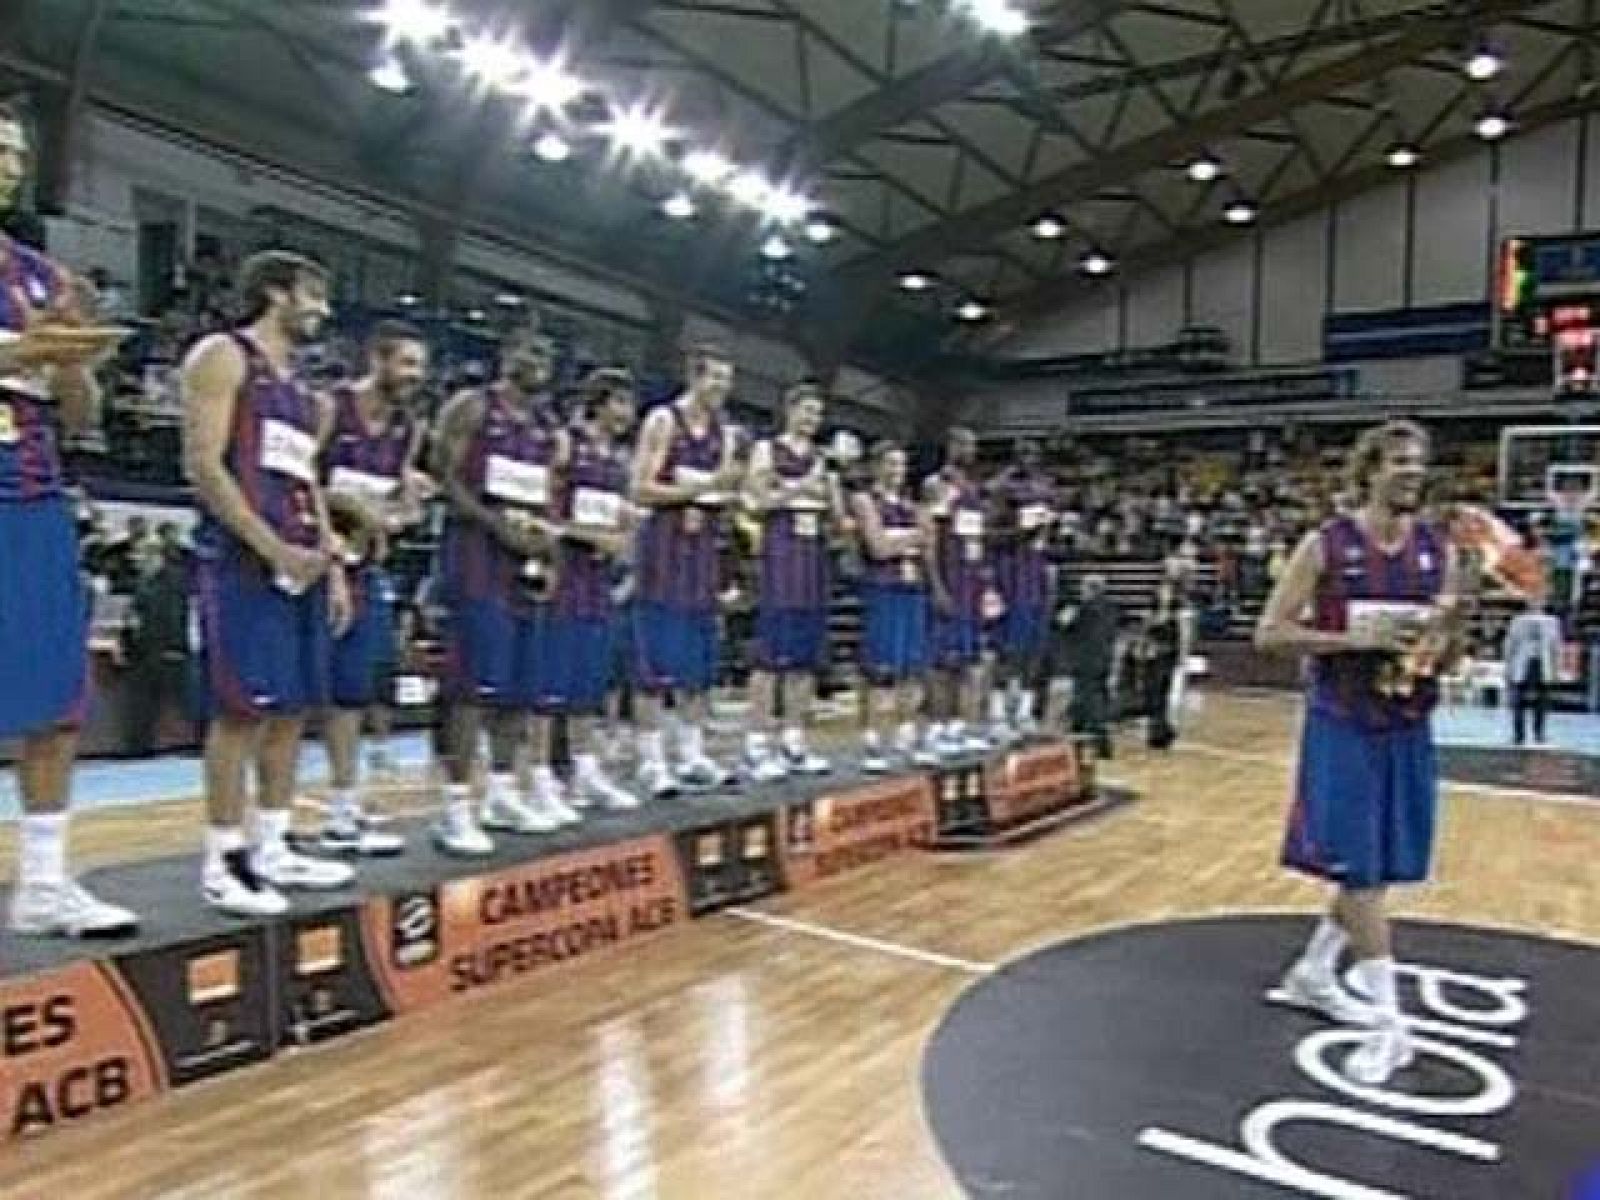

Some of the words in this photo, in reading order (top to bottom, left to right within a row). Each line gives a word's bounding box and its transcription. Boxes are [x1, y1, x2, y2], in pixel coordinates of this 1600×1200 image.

[479, 851, 654, 925] CAMPEONES
[4, 996, 76, 1056] ES
[12, 1057, 131, 1134] ACB
